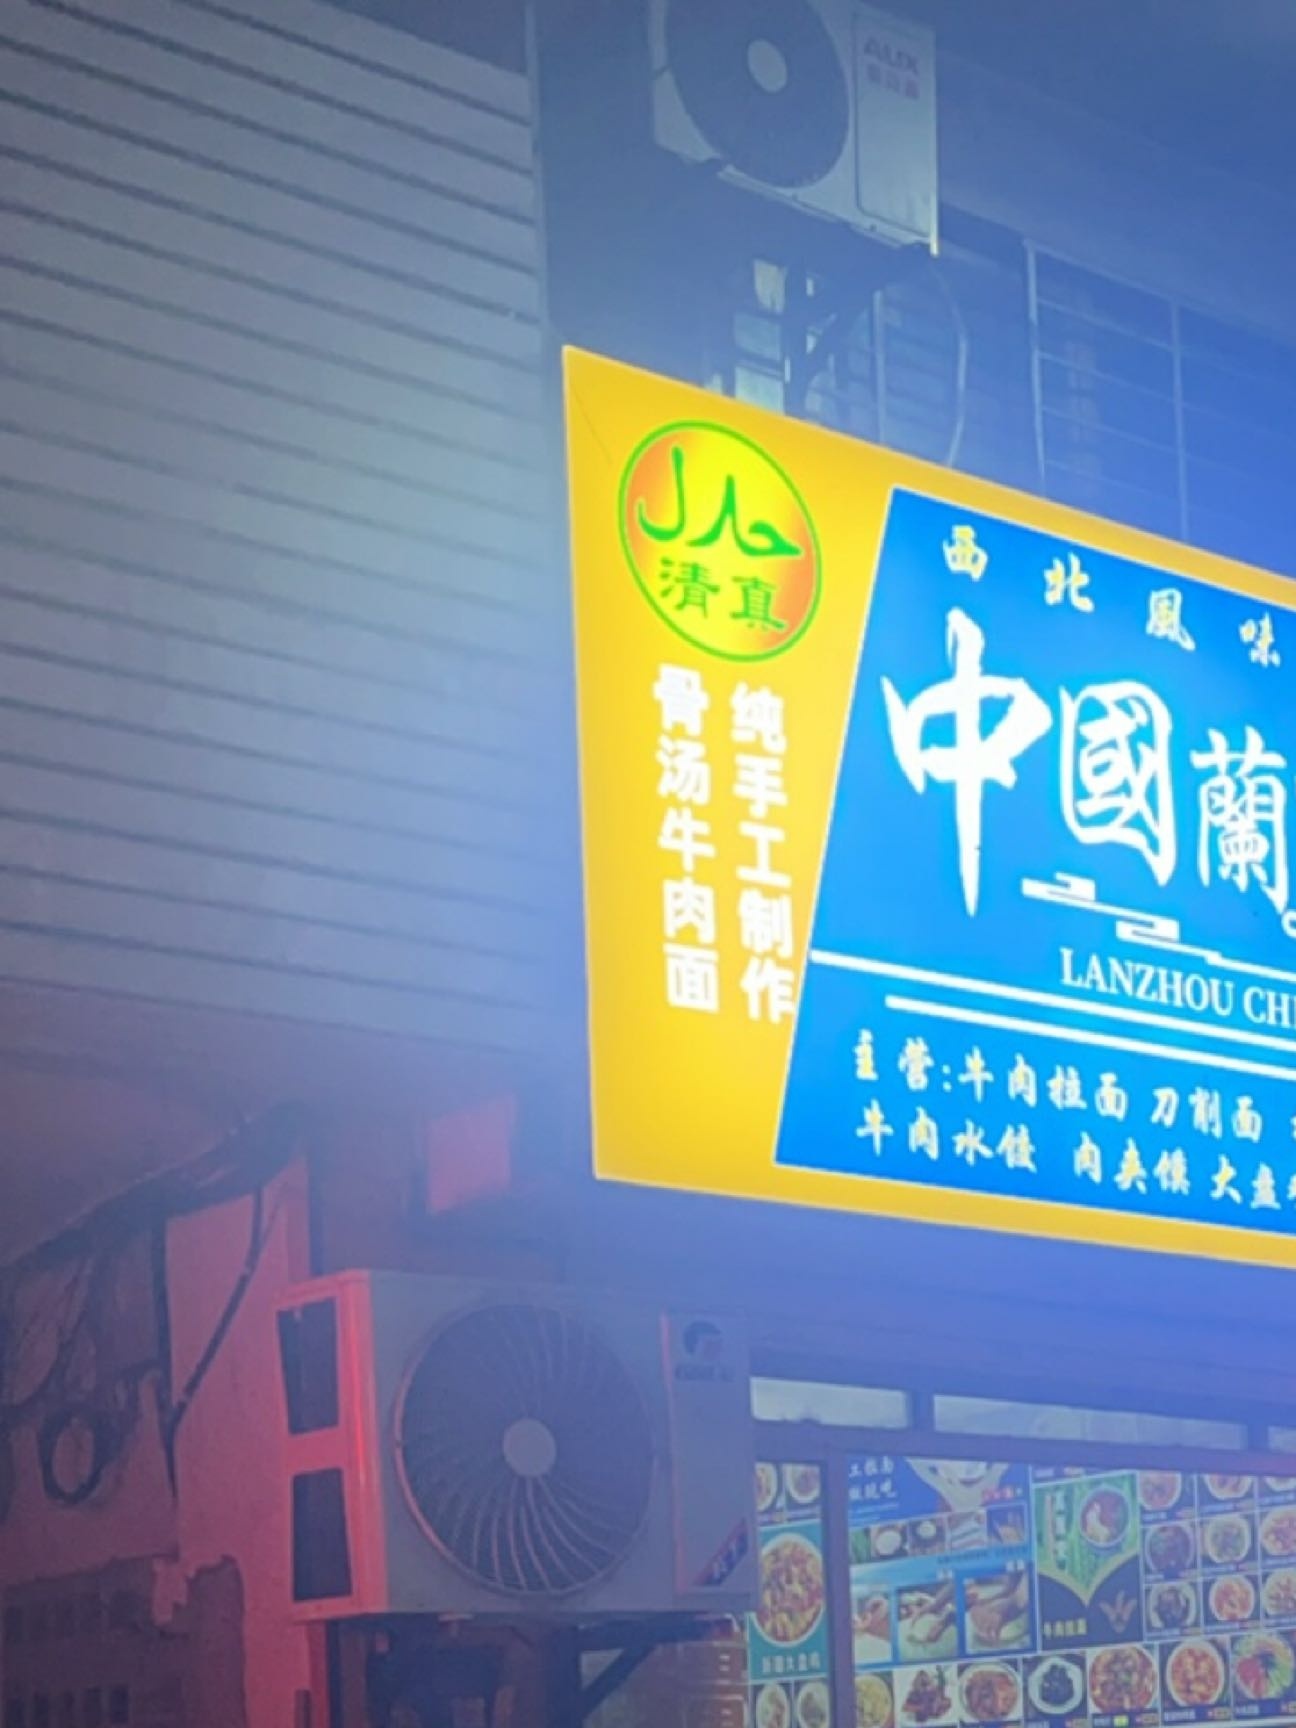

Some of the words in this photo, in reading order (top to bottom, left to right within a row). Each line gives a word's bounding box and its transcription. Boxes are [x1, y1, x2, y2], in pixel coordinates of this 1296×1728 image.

[659, 557, 787, 632] 清真
[652, 662, 721, 1014] 骨汤牛肉面
[728, 680, 796, 1024] 纯手工制作
[1060, 946, 1236, 1014] LANZHOU
